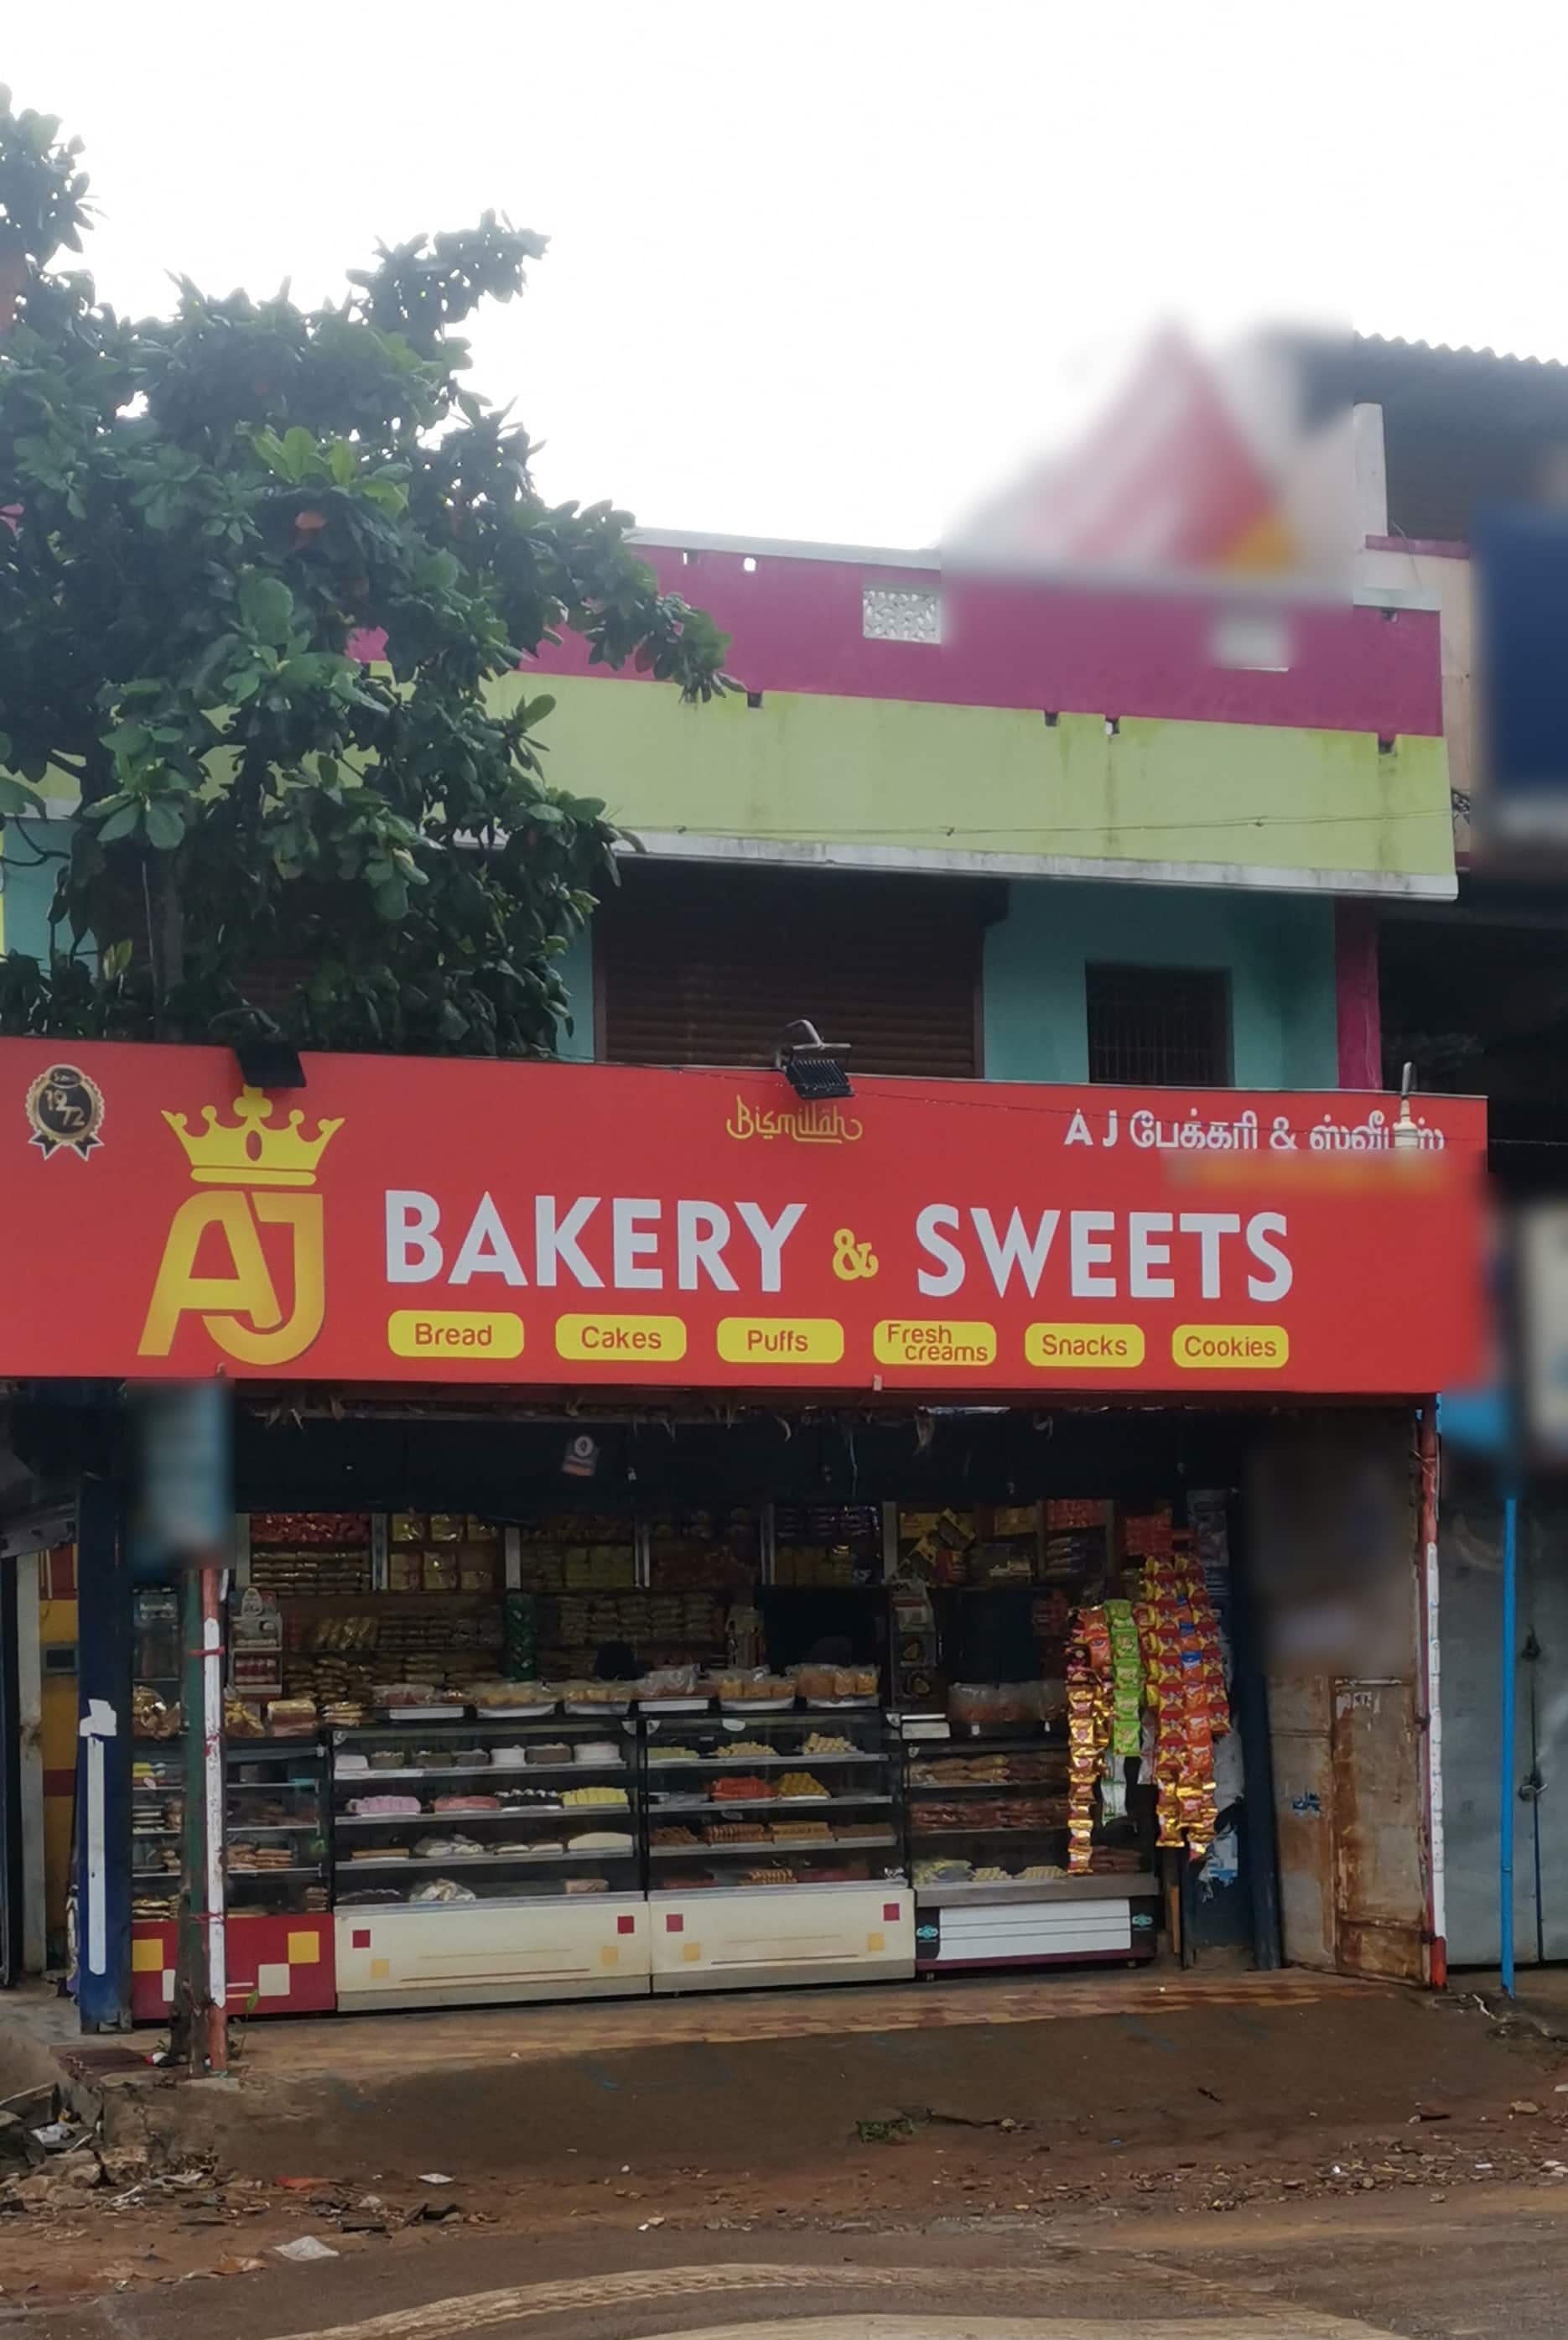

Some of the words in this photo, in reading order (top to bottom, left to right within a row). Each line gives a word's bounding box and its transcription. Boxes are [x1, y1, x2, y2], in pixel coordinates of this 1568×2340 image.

[1064, 1108, 1093, 1146] A
[1102, 1110, 1118, 1147] J
[1269, 1116, 1298, 1150] &
[385, 1190, 807, 1292] BAKERY
[833, 1229, 878, 1281] &
[916, 1204, 1294, 1303] SWEETS
[138, 1190, 325, 1365] AJ
[414, 1323, 493, 1347] Bread
[580, 1326, 662, 1350] Cakes
[746, 1329, 809, 1353] Puffs
[887, 1323, 952, 1344] Fresh
[1041, 1334, 1128, 1358] Snacks
[1184, 1335, 1277, 1359] Cookies
